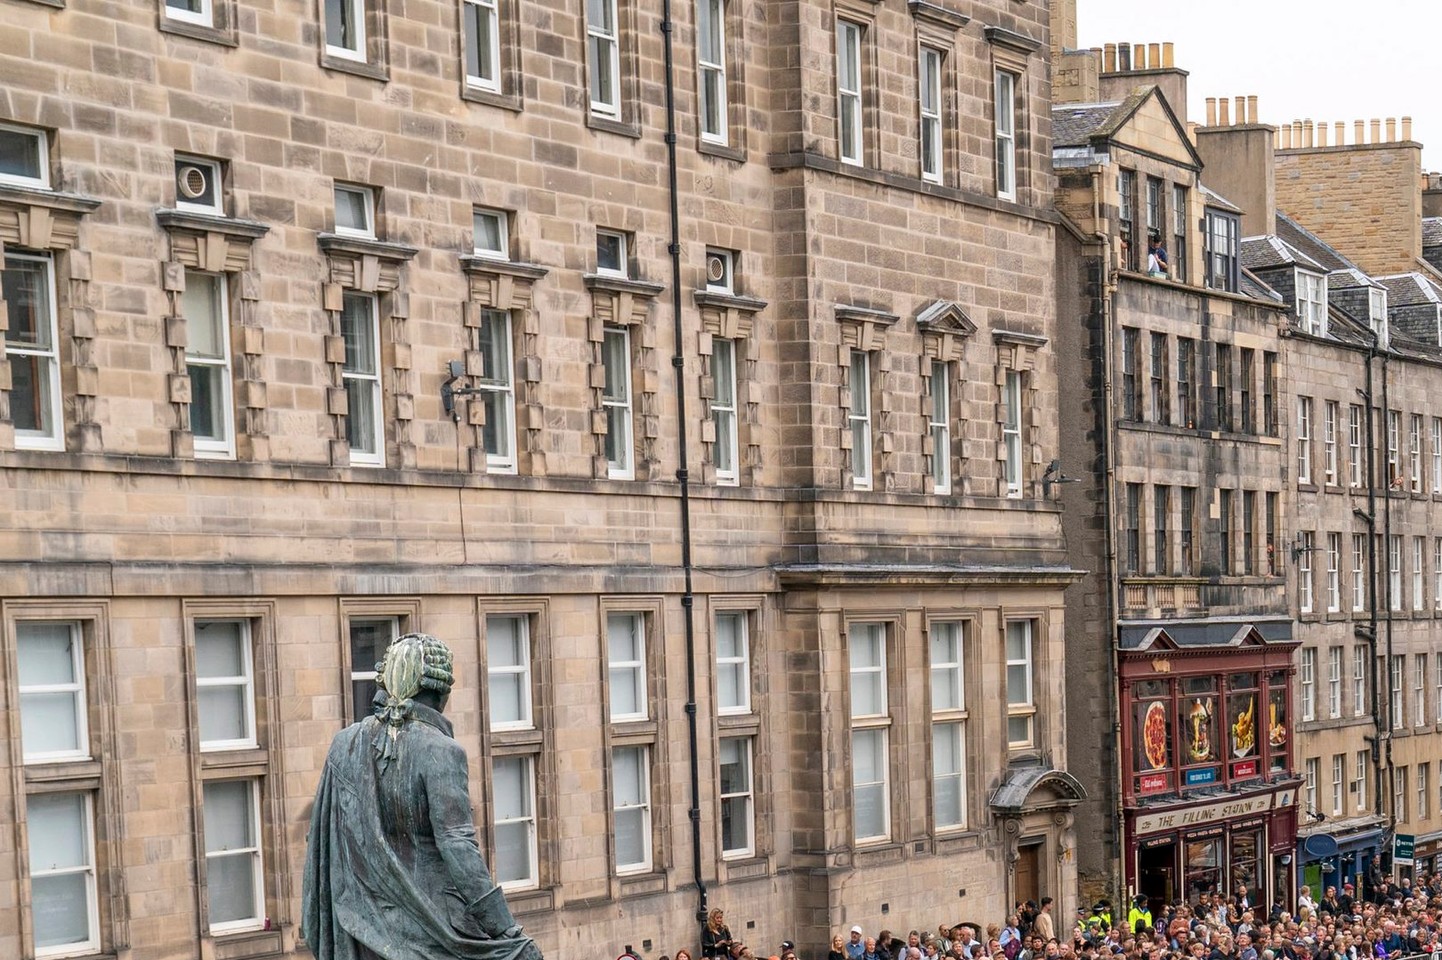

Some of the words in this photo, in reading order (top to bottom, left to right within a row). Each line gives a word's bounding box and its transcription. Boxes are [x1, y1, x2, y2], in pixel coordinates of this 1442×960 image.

[1158, 814, 1175, 828] THE
[1182, 808, 1216, 823] FILLING
[1221, 801, 1253, 817] STATION
